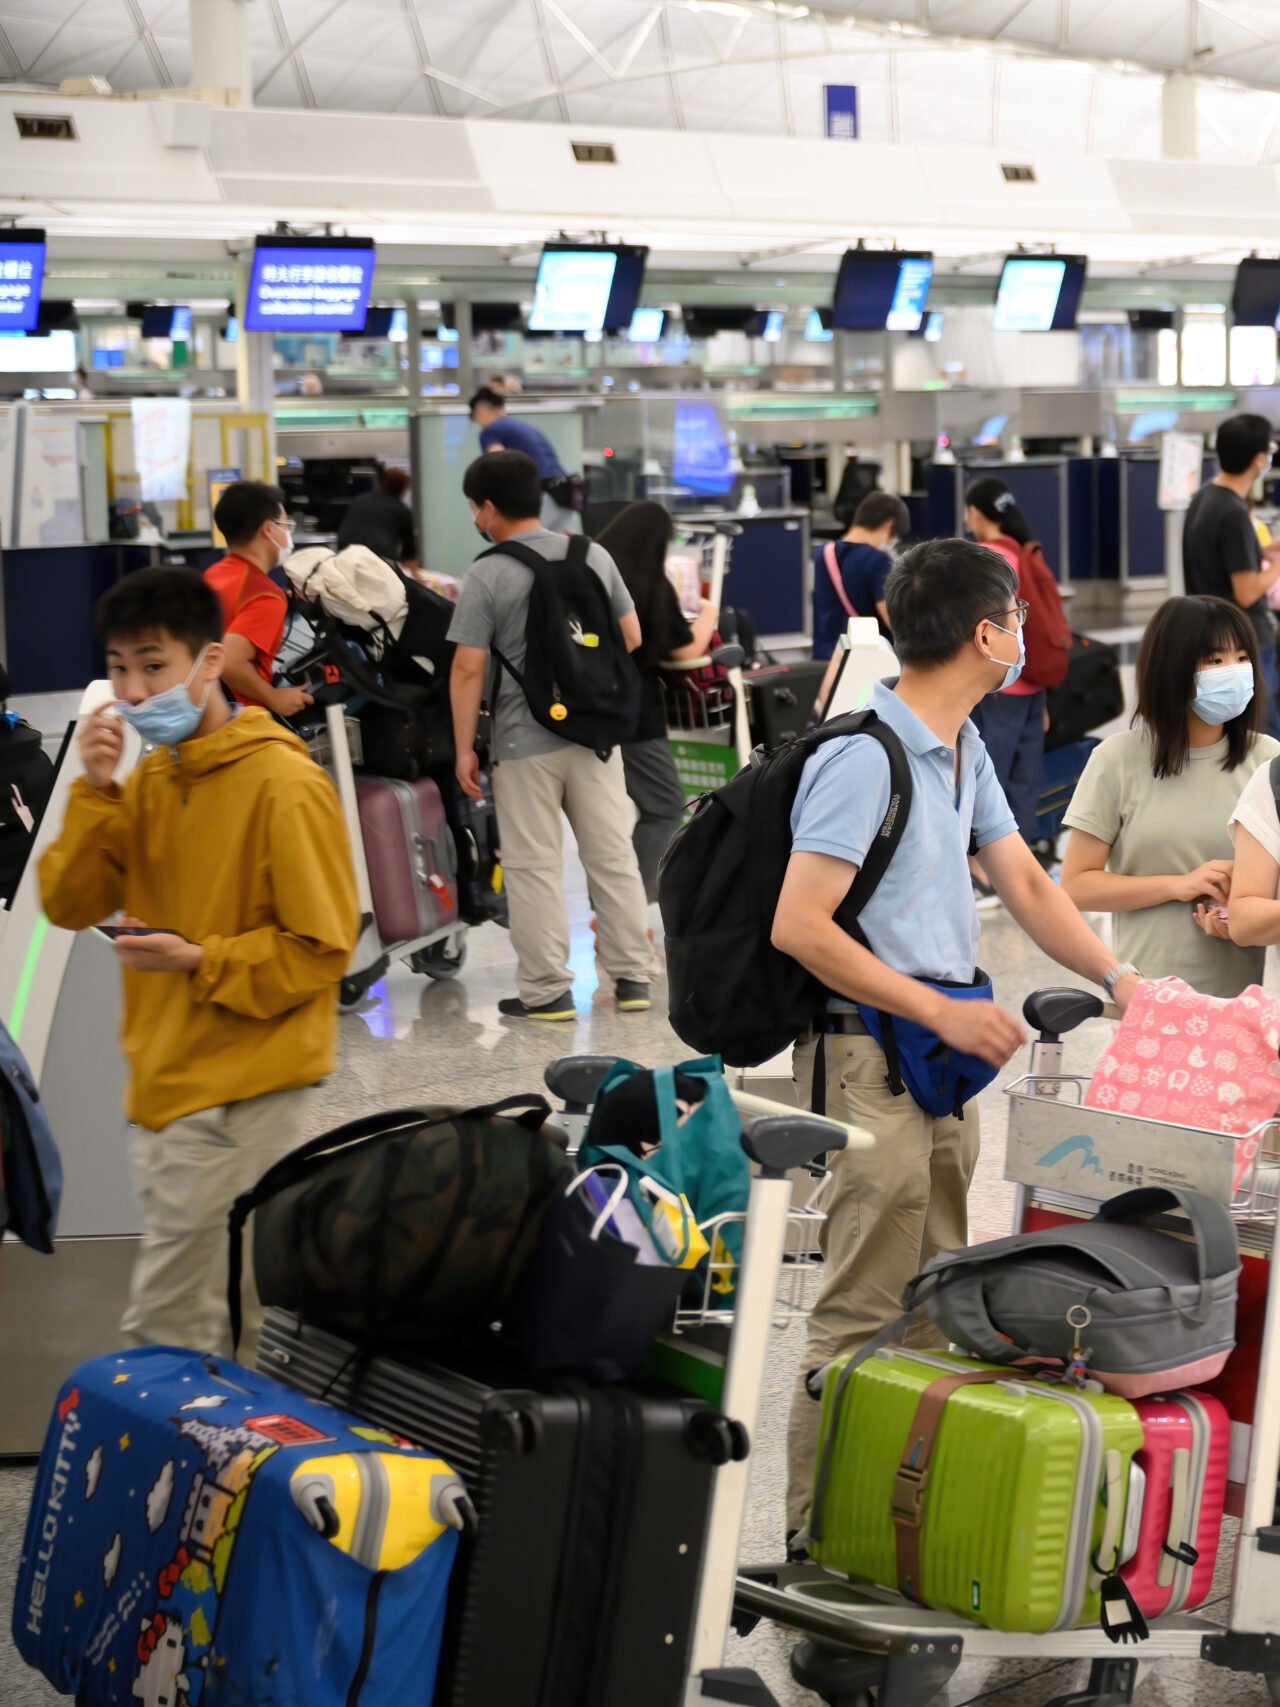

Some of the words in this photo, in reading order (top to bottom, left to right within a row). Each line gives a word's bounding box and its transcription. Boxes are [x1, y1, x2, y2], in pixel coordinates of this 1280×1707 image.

[885, 794, 900, 838] AMERICAN
[26, 1513, 59, 1636] HELLO
[47, 1411, 82, 1511] KITTY
